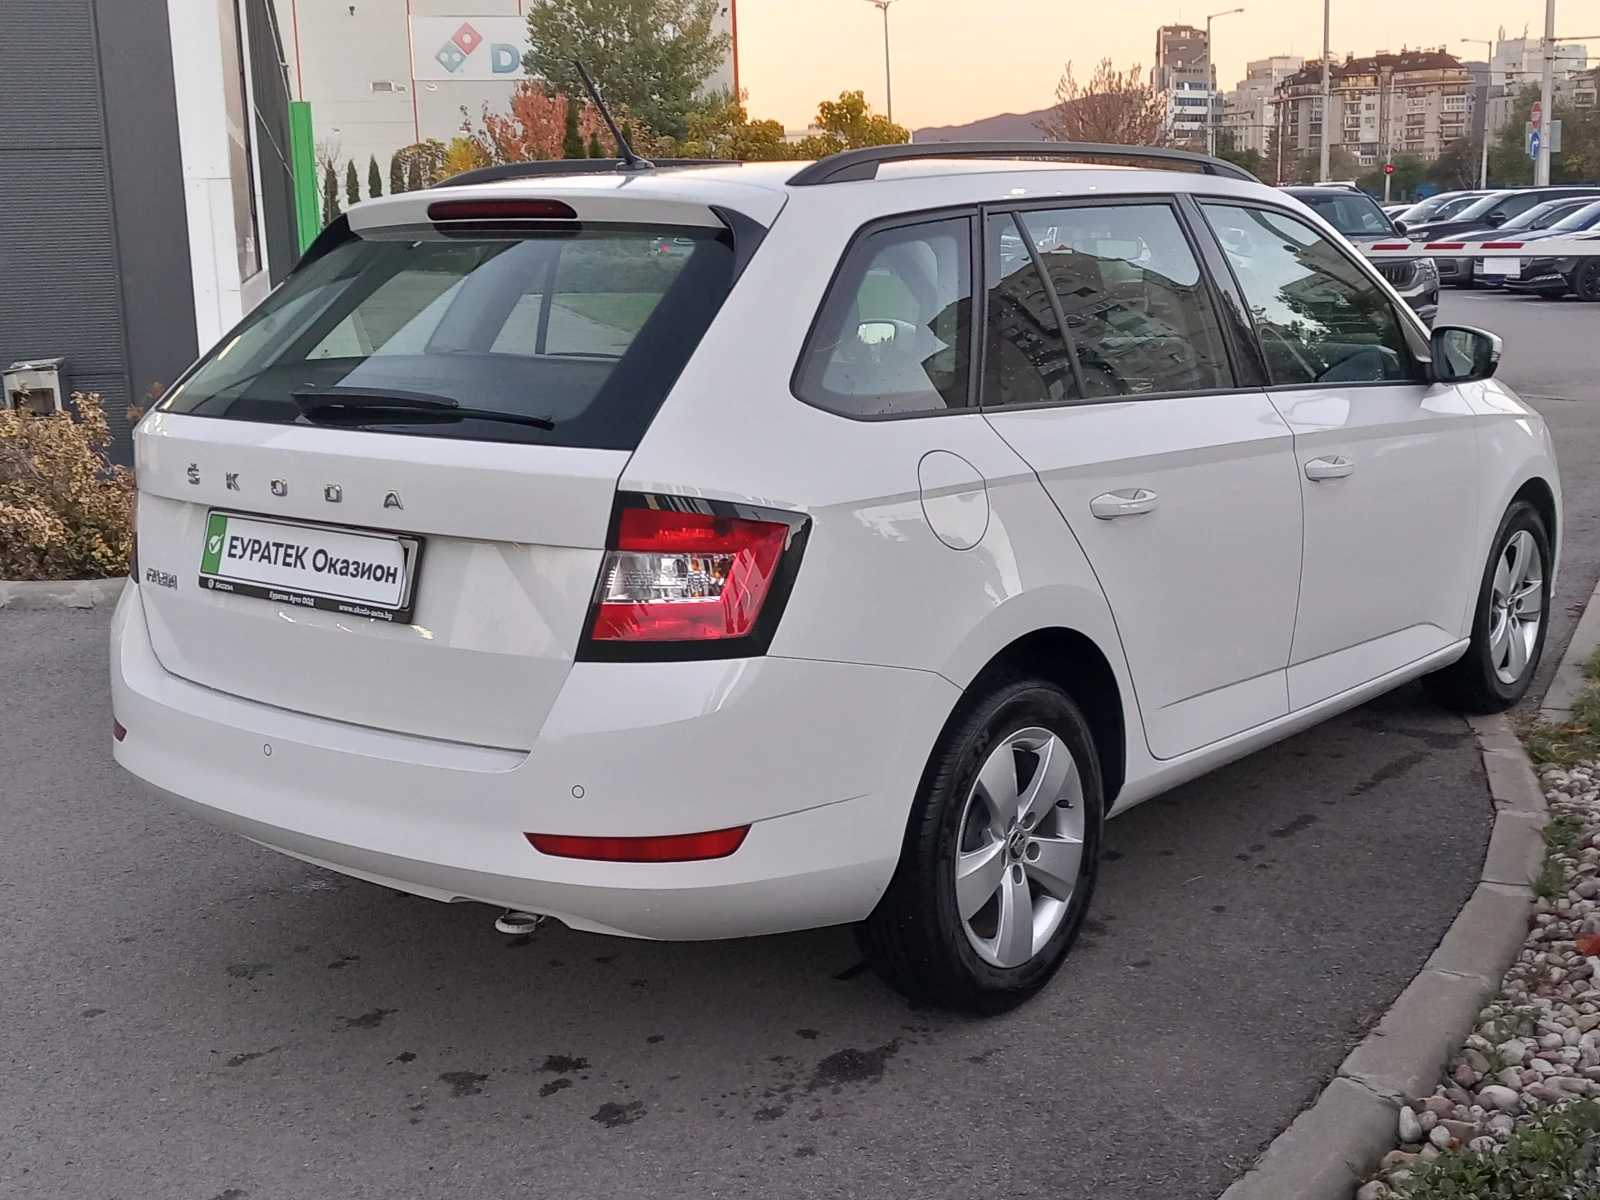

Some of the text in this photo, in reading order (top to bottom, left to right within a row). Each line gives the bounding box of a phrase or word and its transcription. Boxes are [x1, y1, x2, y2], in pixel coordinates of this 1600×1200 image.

[187, 462, 404, 510] ŠKODA
[227, 535, 398, 584] ЕУРАТЕК Оказион
